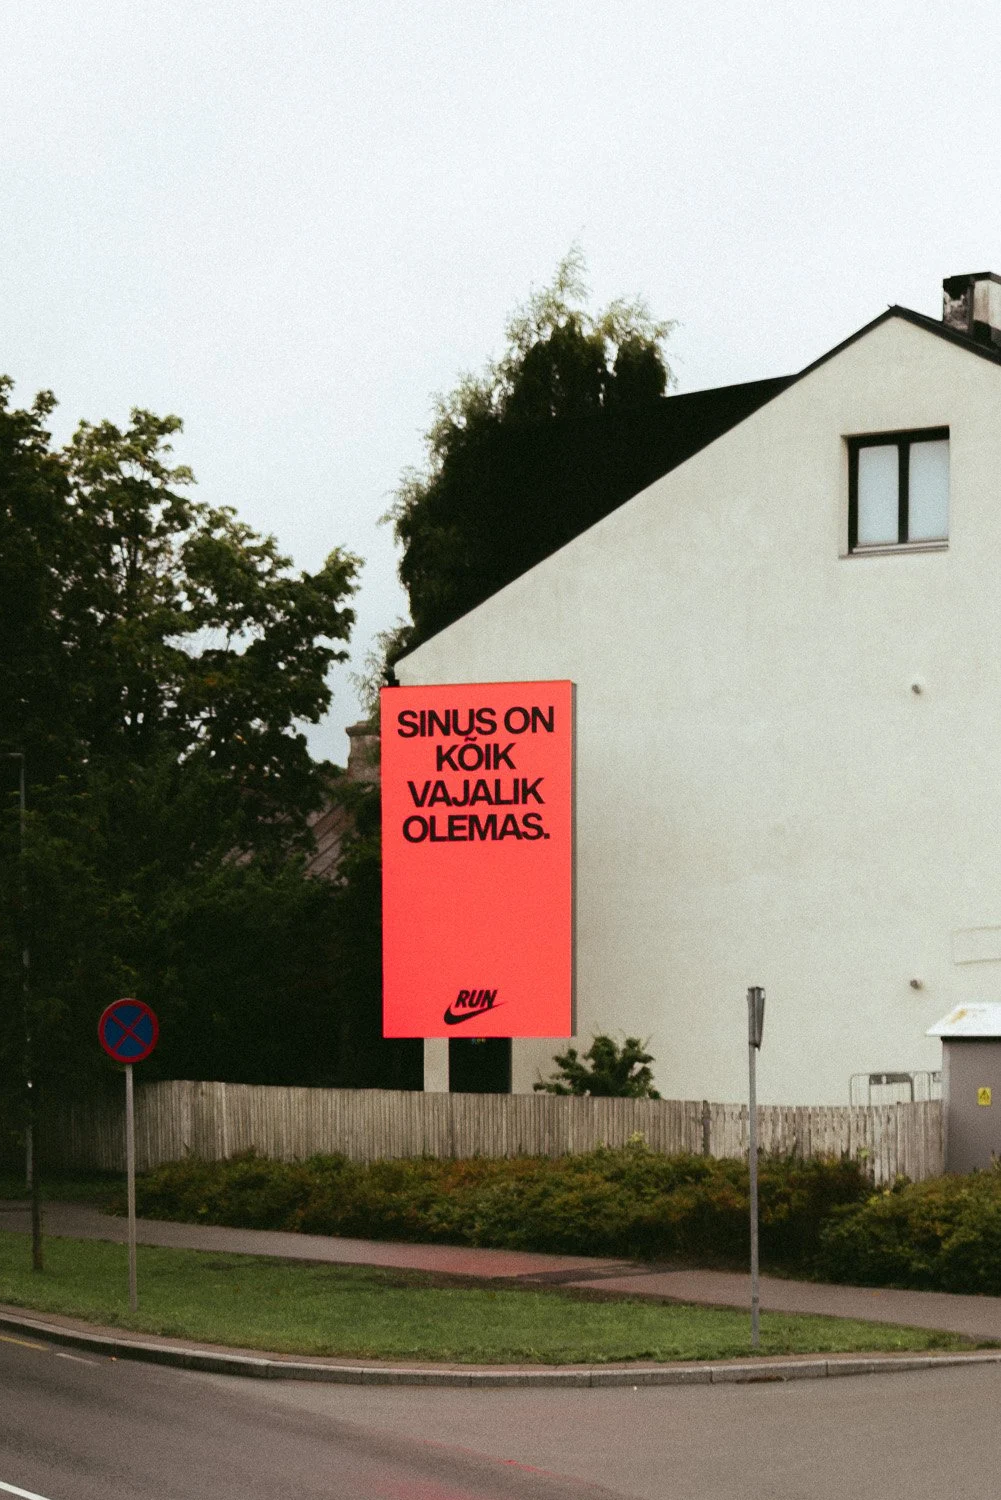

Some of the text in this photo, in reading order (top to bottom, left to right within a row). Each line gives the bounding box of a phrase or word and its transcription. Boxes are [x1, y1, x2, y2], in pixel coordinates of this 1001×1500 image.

[397, 706, 555, 737] SINUS ON
[436, 737, 516, 772] KÕIK
[407, 777, 545, 808] VAJALIK
[402, 812, 550, 843] OLEMAS.
[455, 989, 497, 1009] RUN
